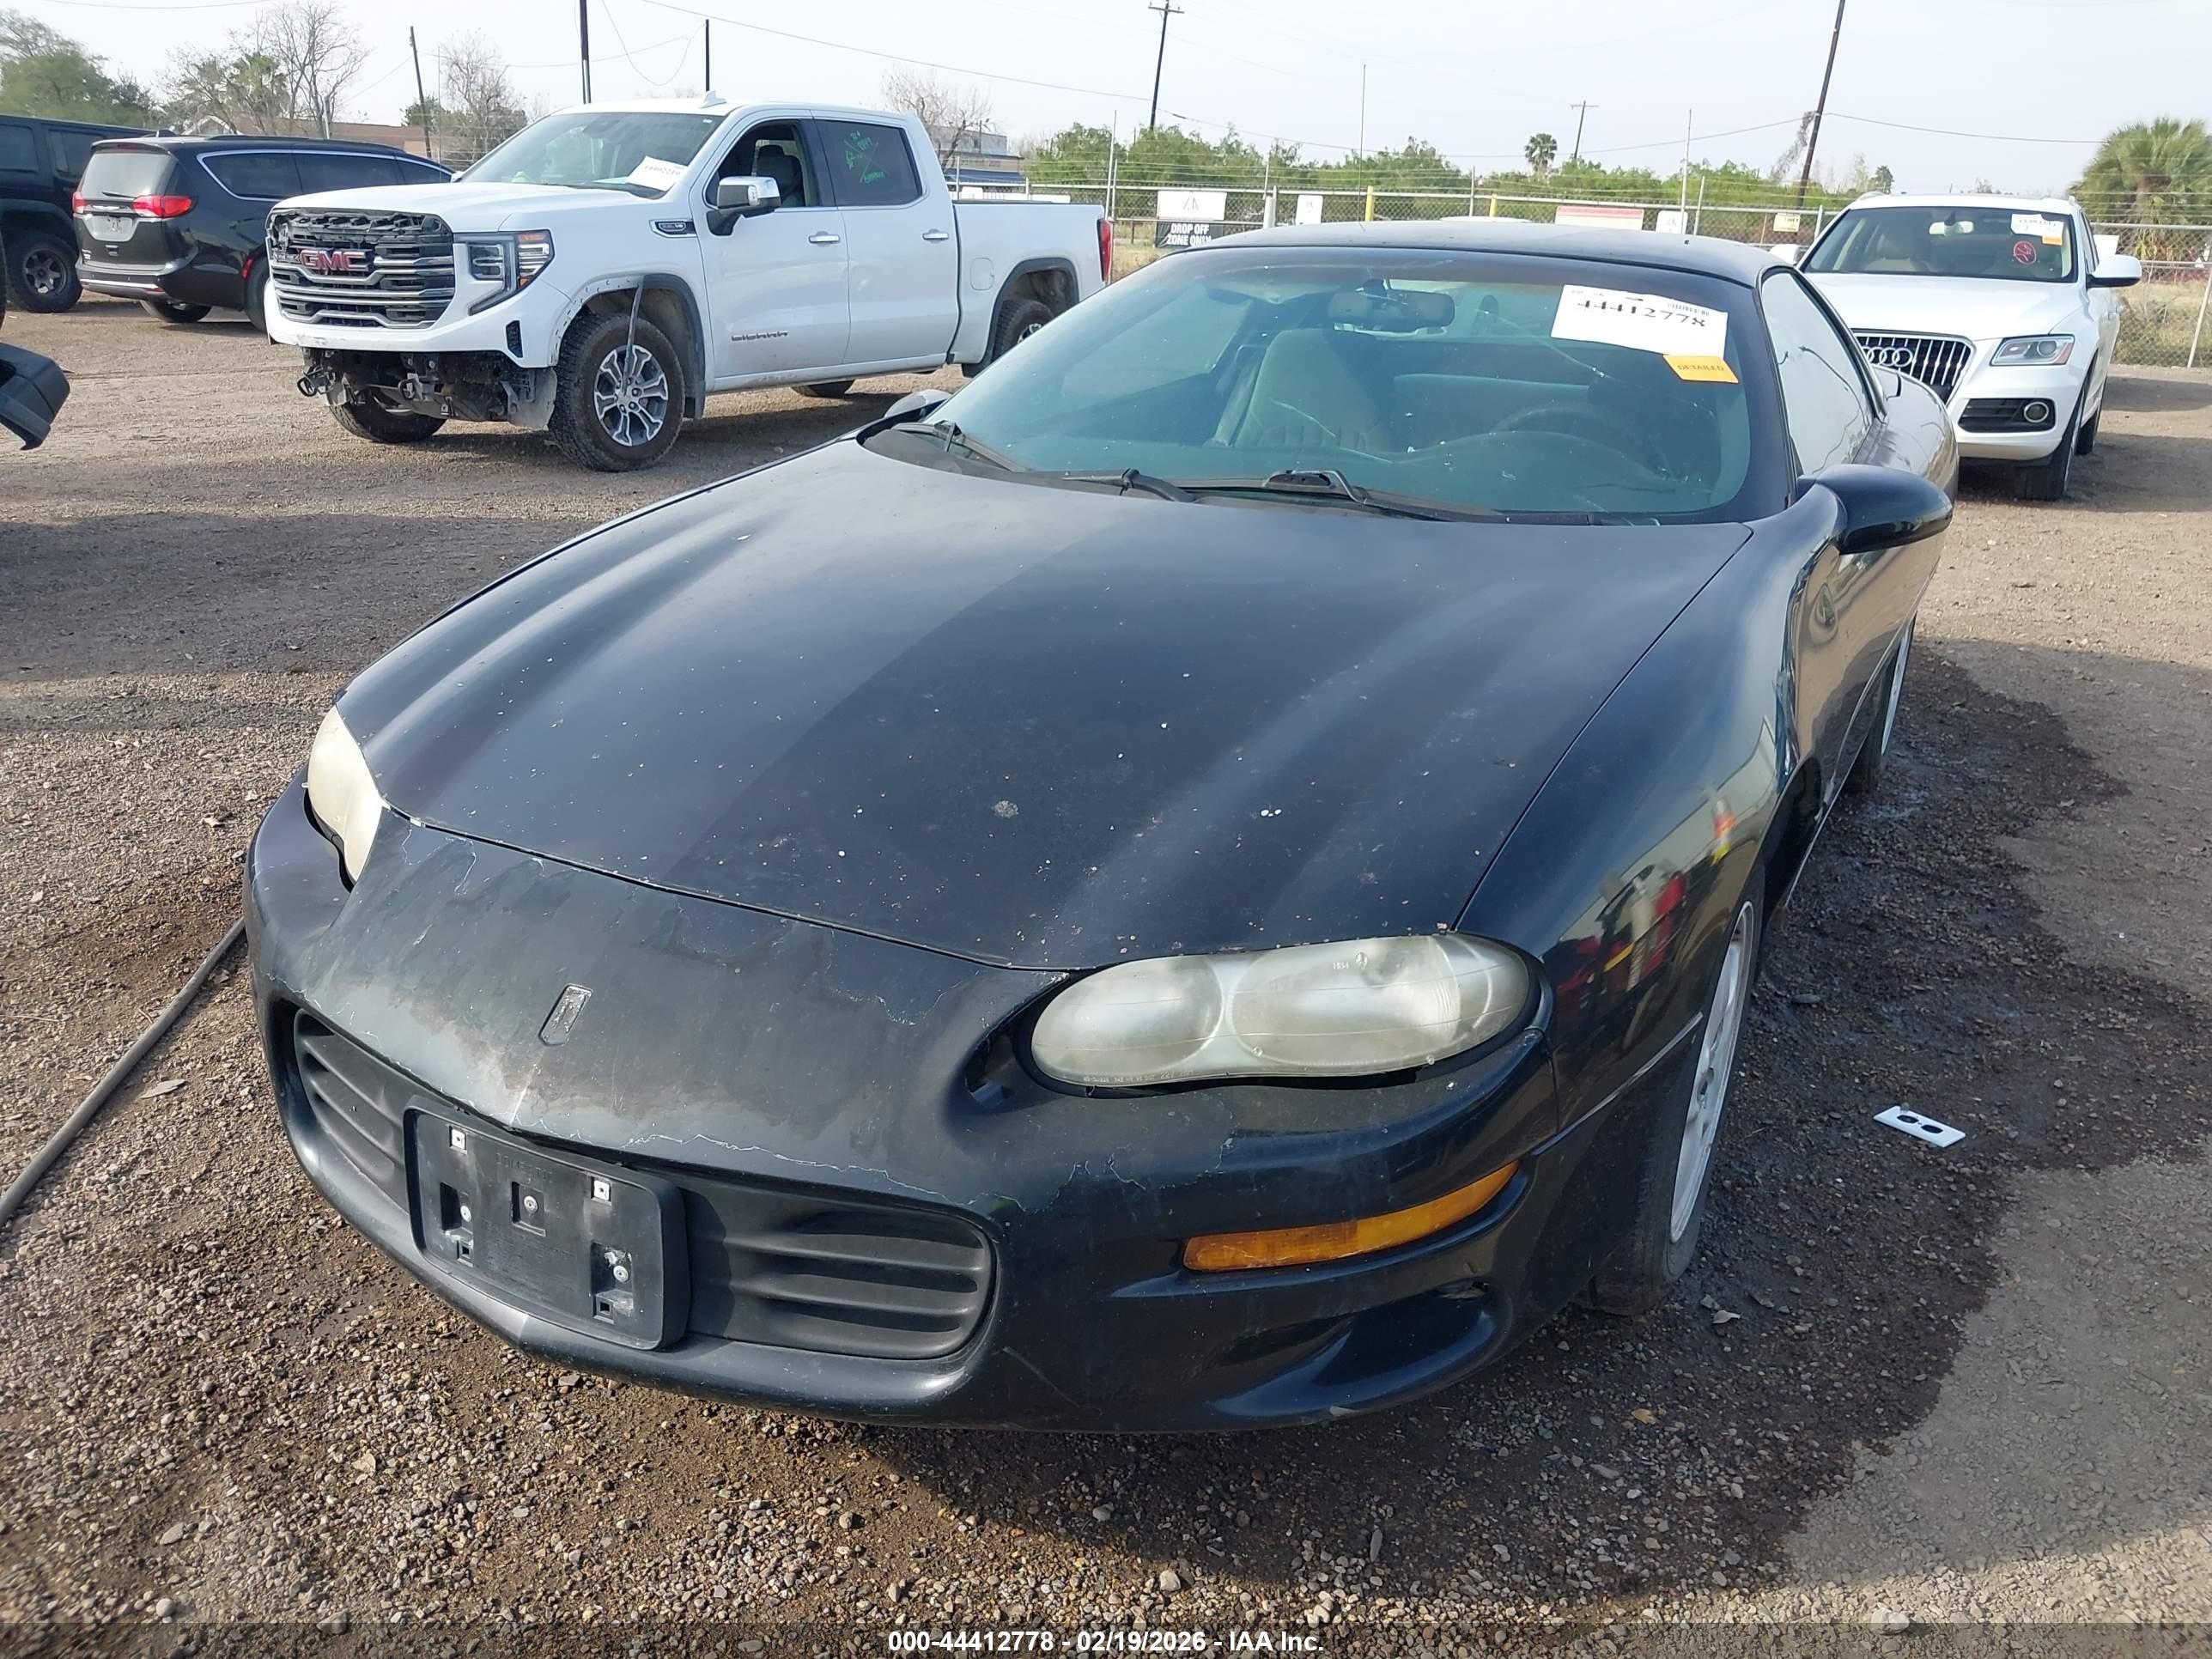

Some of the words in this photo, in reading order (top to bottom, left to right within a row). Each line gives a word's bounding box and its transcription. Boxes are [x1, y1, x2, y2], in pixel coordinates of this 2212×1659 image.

[1170, 223, 1193, 234] DROP
[1194, 223, 1209, 234] OFF
[1167, 234, 1188, 246] ZONE
[300, 249, 369, 271] GMC
[1577, 300, 1705, 327] 44412778
